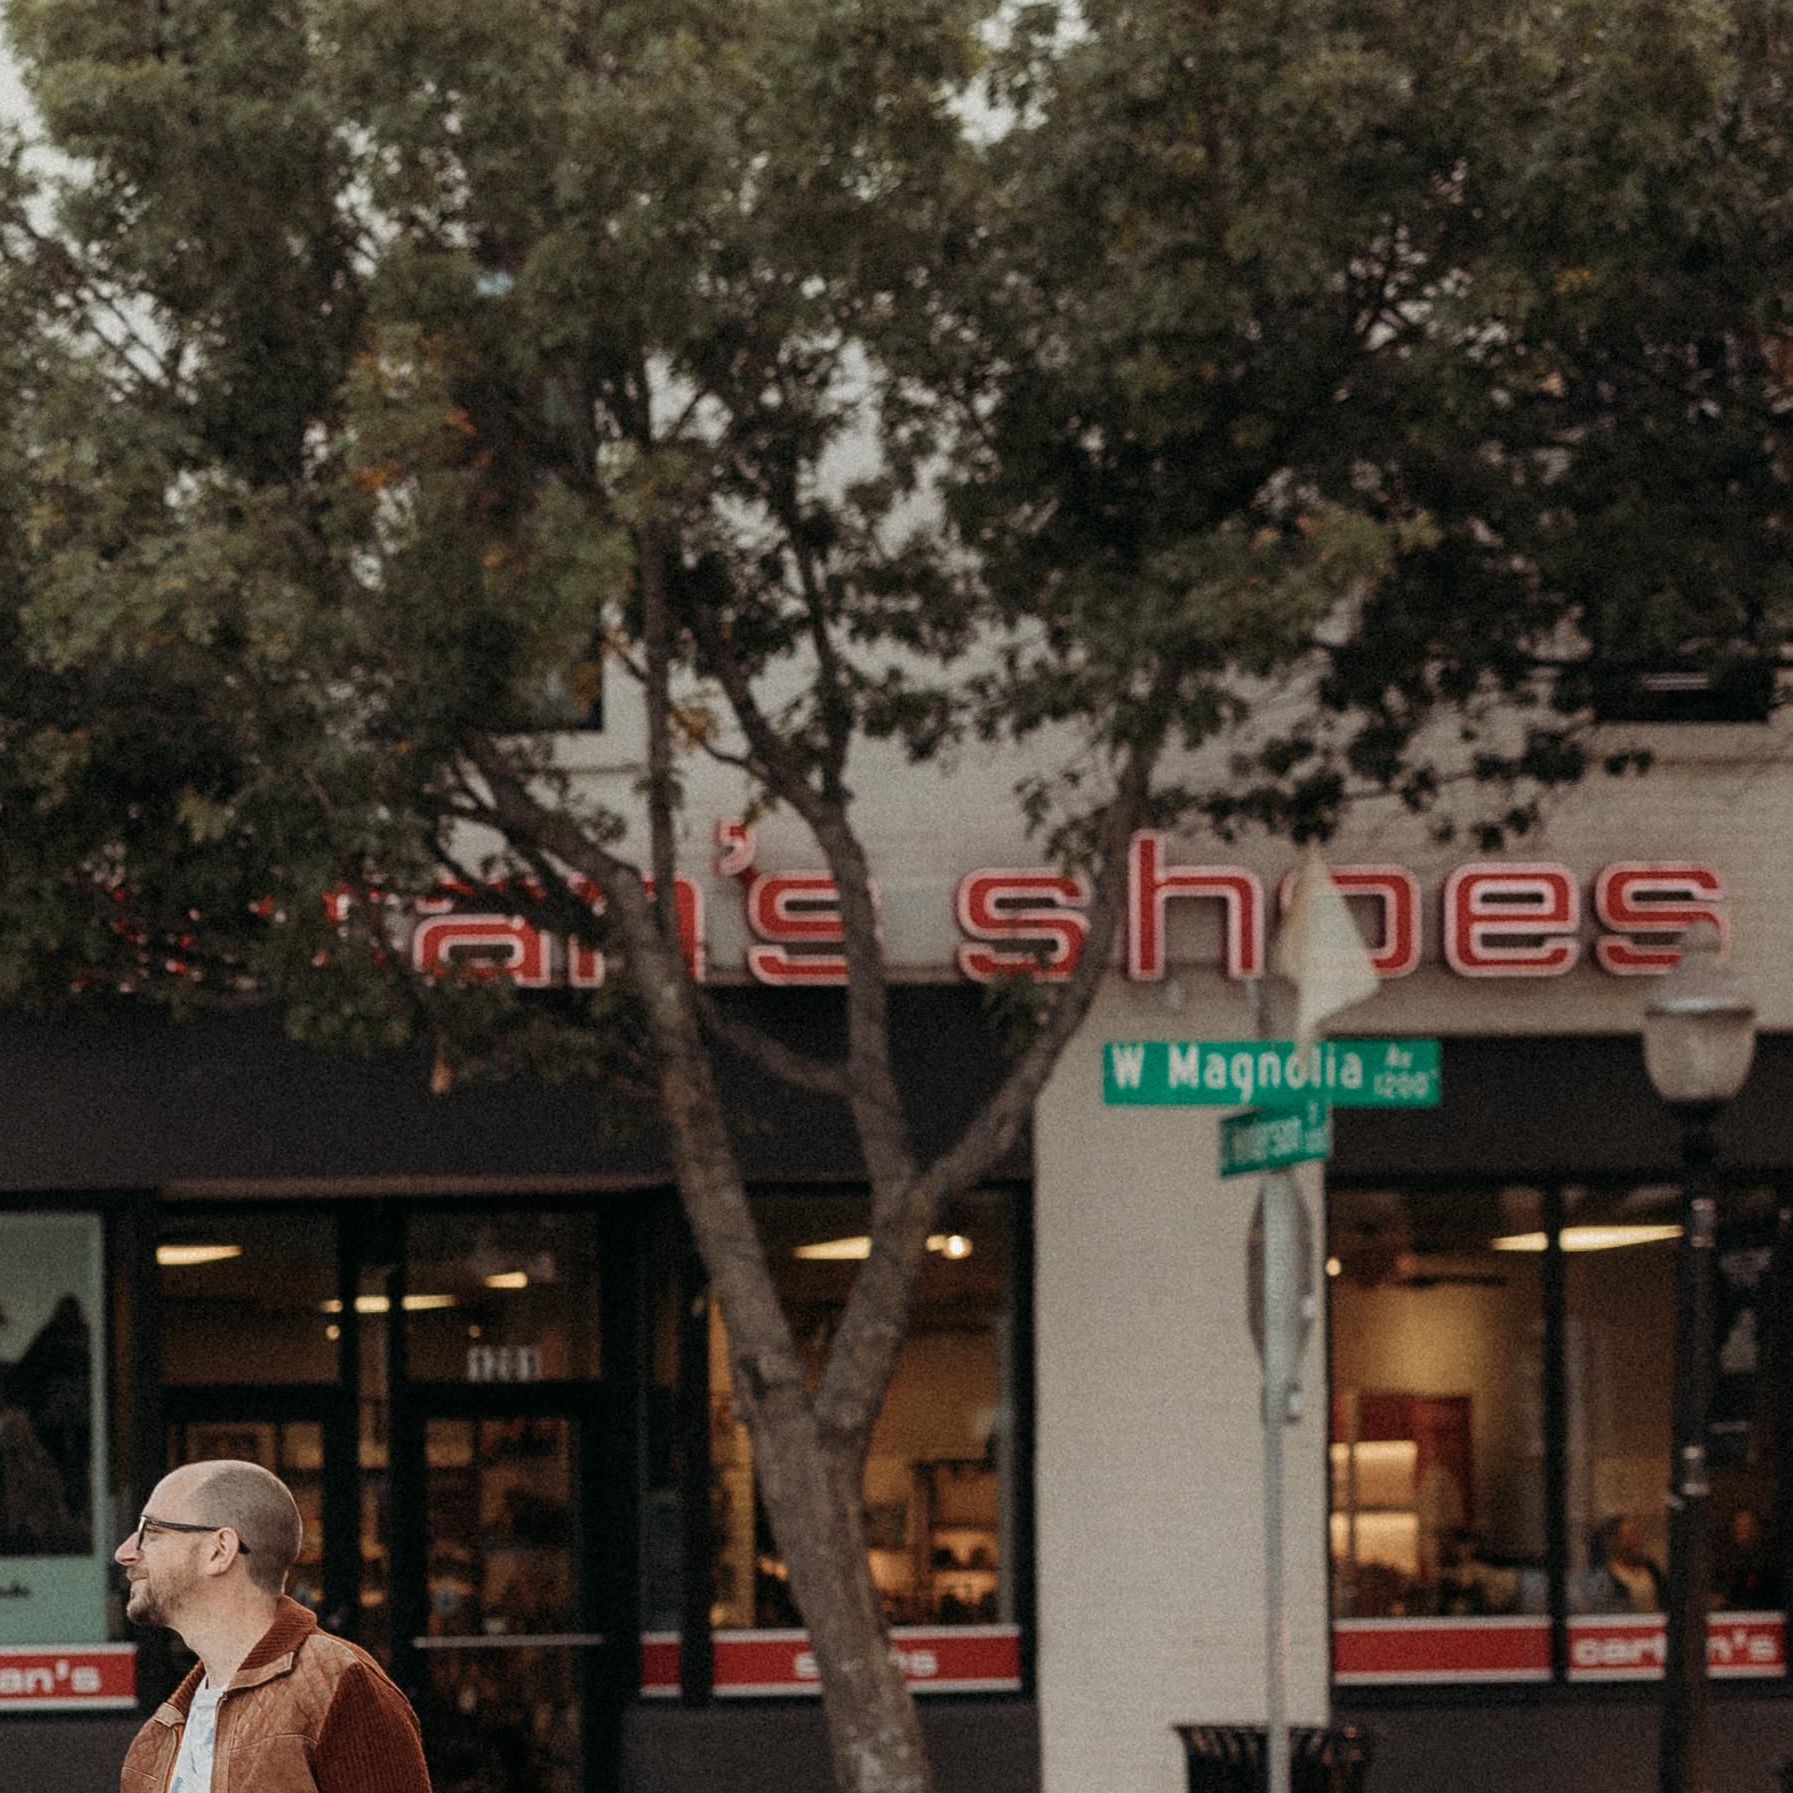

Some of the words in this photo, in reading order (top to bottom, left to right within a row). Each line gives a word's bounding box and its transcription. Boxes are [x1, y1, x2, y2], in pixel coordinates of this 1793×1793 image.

[957, 829, 1727, 981] shoes
[1113, 1042, 1145, 1089] W
[1168, 1042, 1363, 1104] Magnolia
[1572, 1629, 1779, 1666] cartn's
